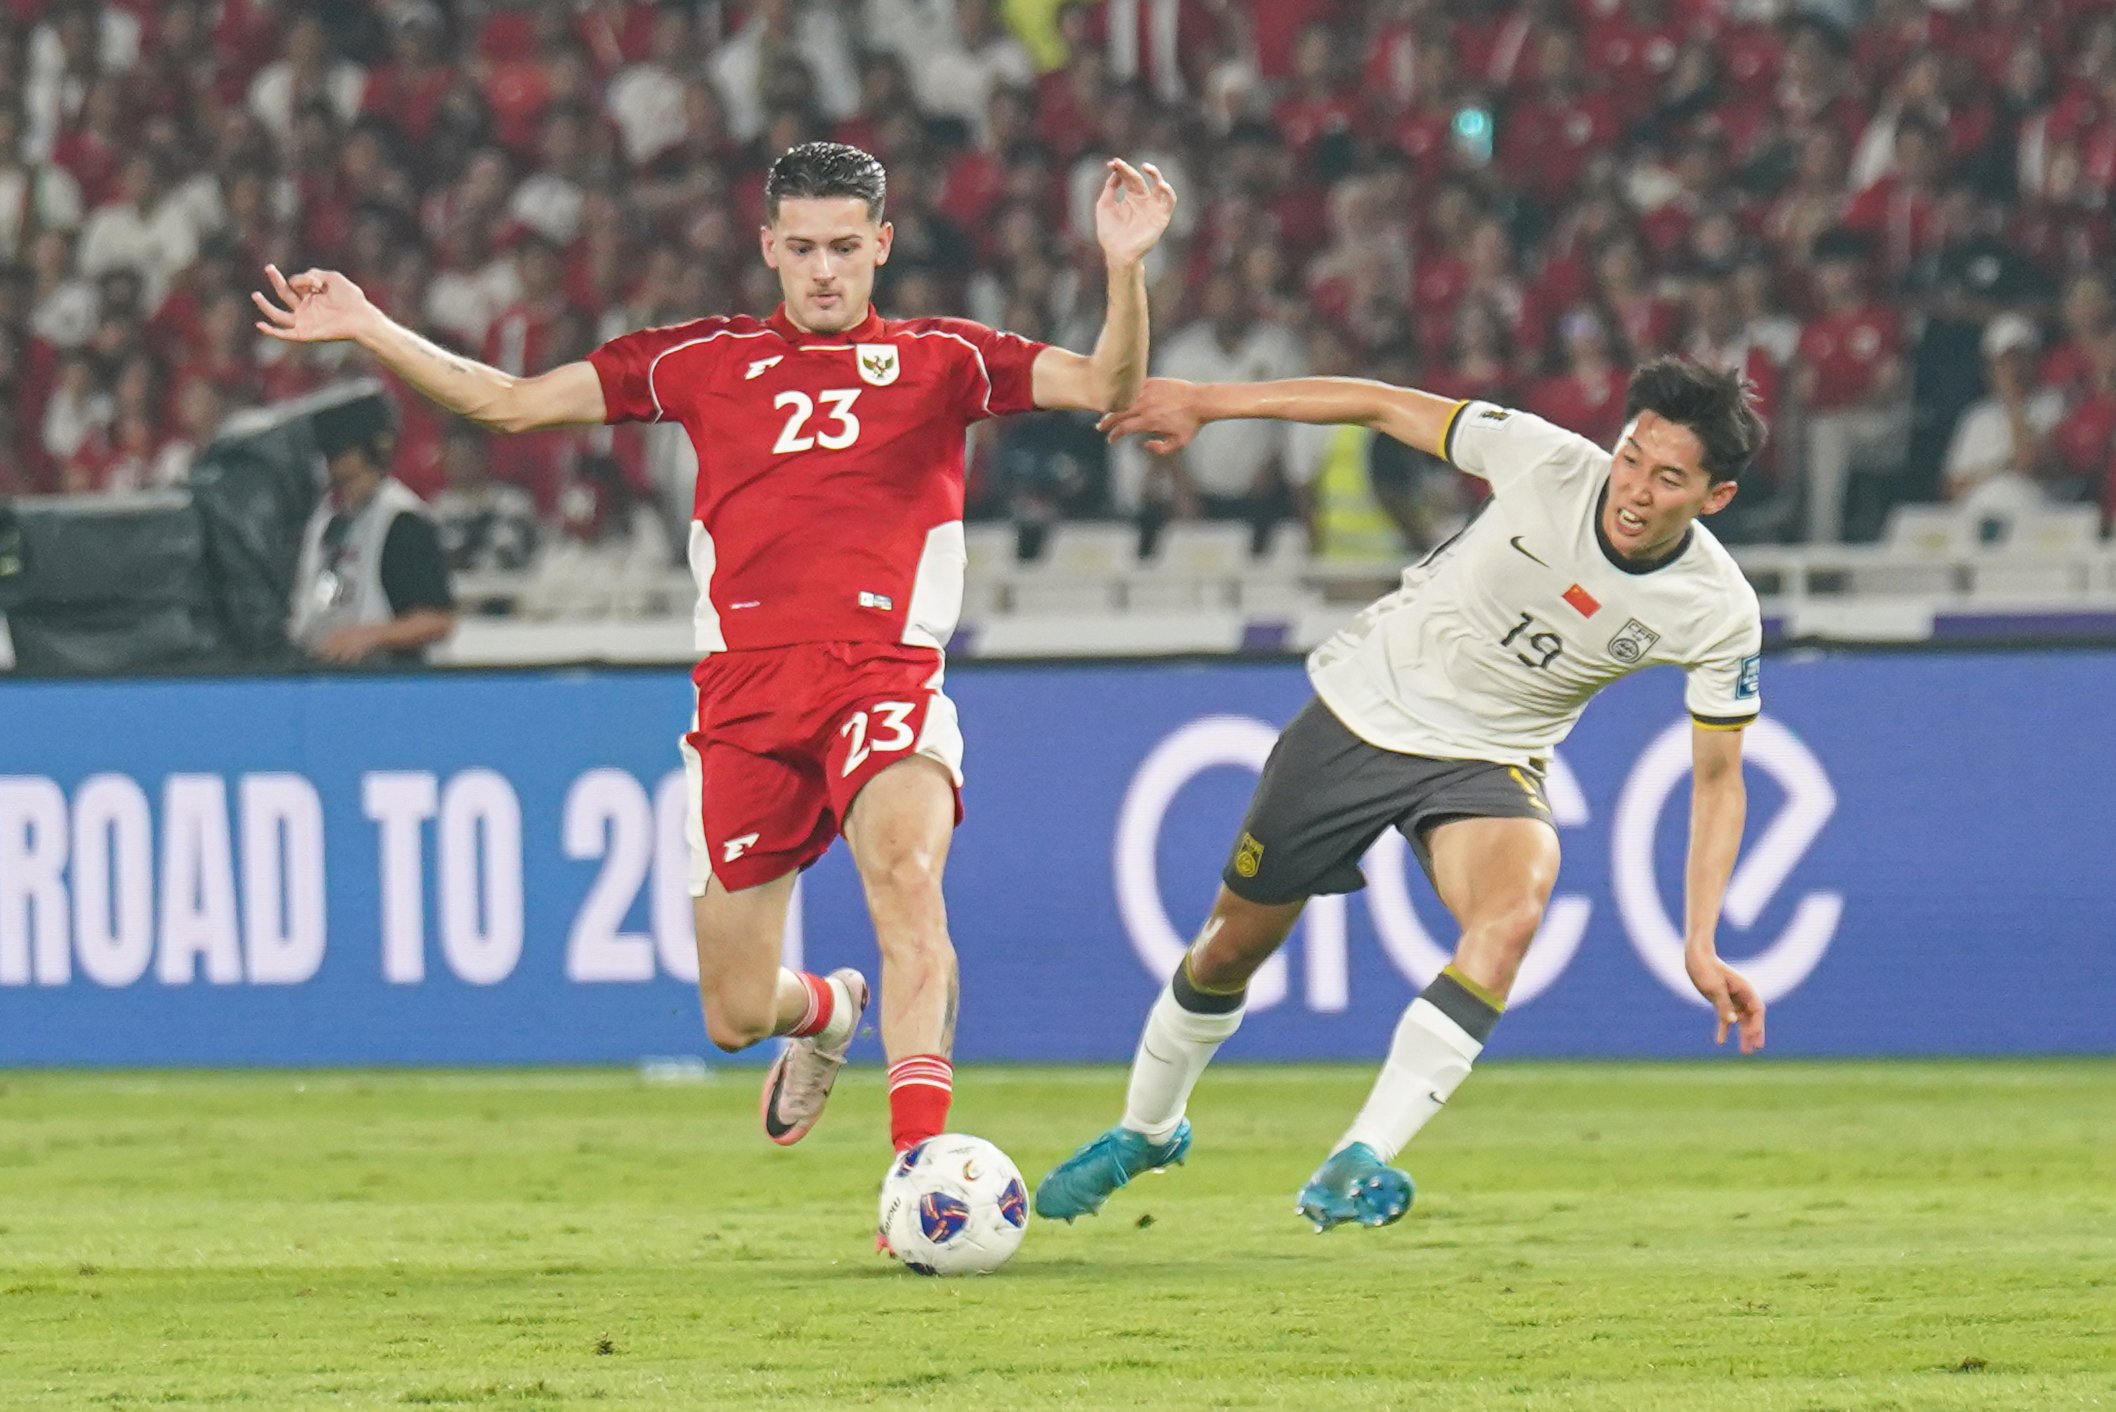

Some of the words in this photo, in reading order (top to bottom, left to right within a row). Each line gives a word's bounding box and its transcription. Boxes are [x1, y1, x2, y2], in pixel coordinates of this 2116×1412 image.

[772, 388, 862, 455] 23
[1500, 611, 1564, 671] 19
[840, 700, 917, 778] 23
[0, 771, 327, 987] ROAD
[362, 768, 525, 986] TO
